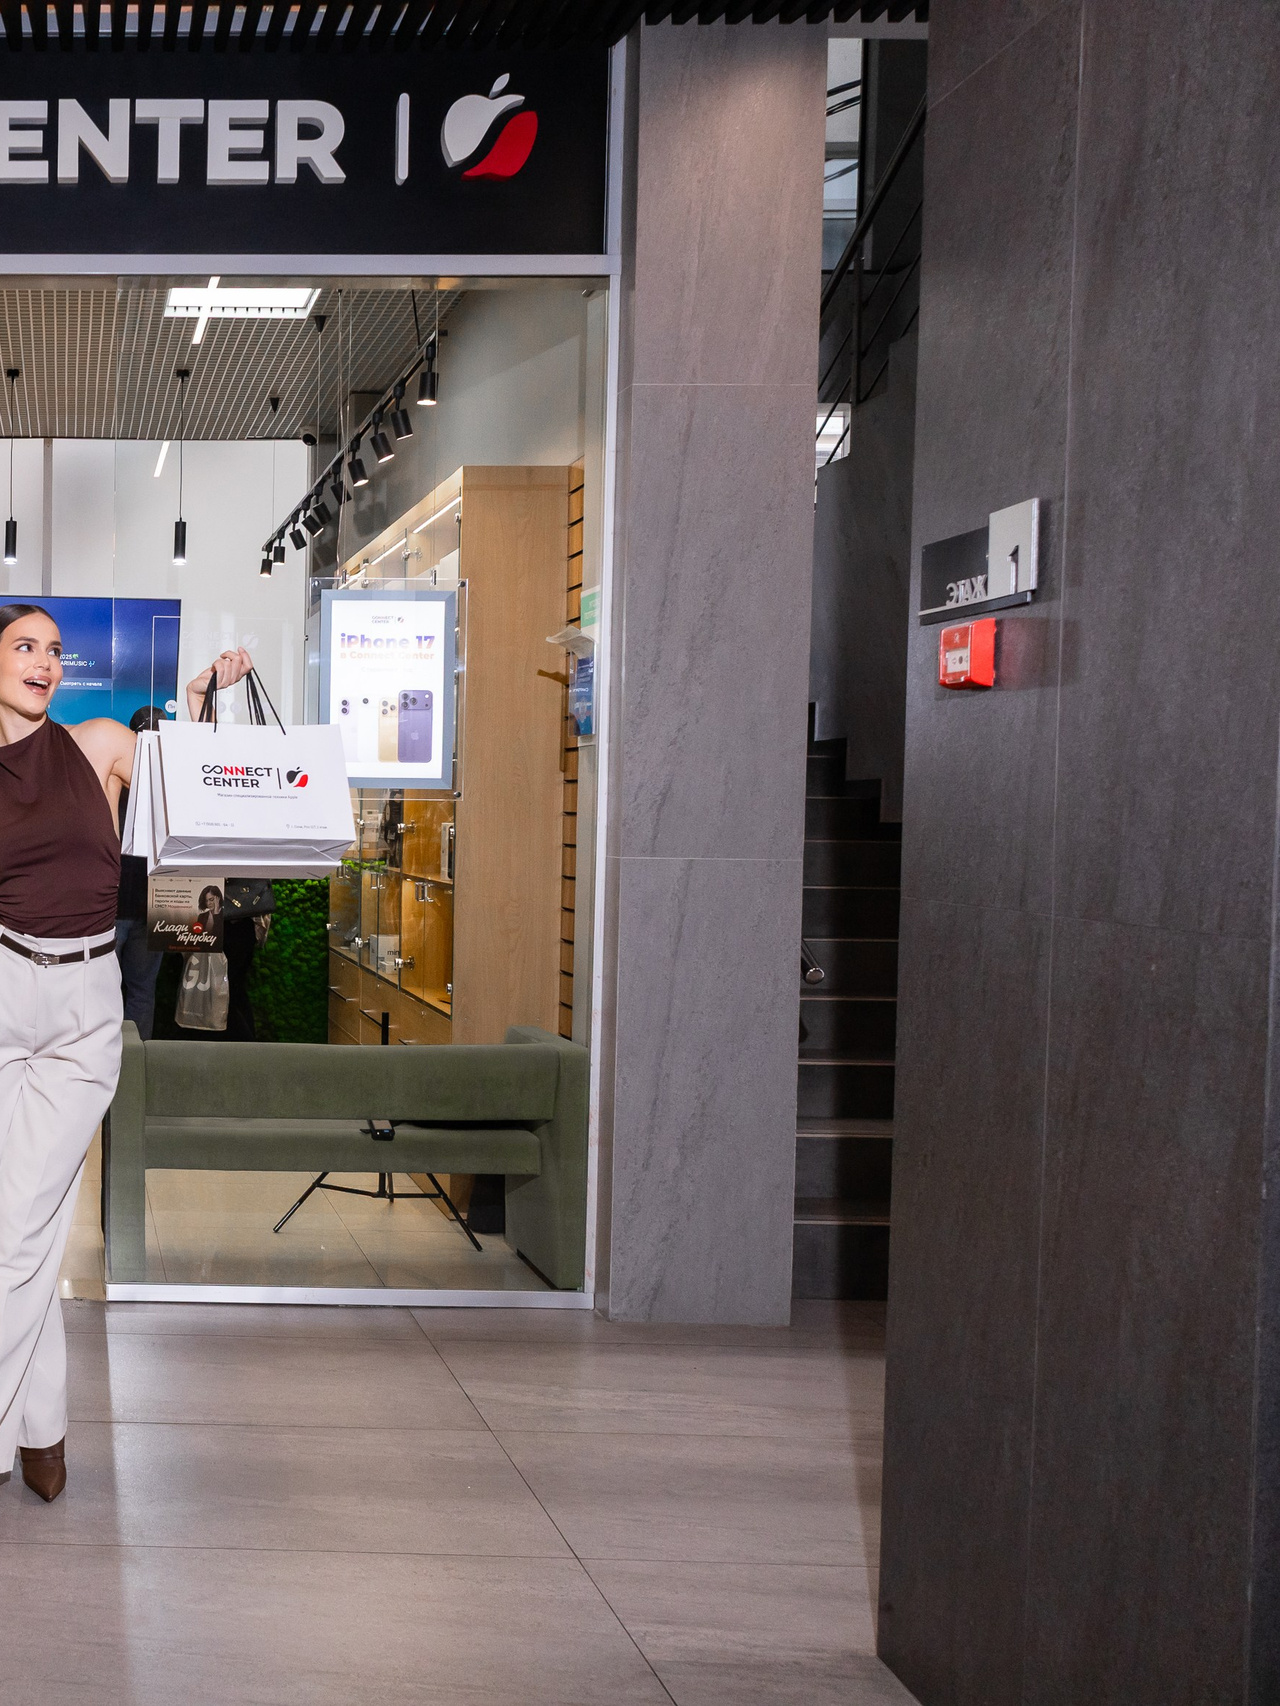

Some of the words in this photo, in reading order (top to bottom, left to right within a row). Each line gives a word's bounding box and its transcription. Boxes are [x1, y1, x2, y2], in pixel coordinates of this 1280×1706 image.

[946, 574, 988, 607] ЭТАЖ
[1006, 545, 1020, 595] 1
[340, 633, 411, 649] iPhone
[415, 635, 436, 650] 17
[349, 651, 394, 660] Connect
[399, 651, 435, 660] Center
[201, 764, 272, 778] CONNECT
[203, 776, 260, 789] CENTER
[153, 920, 189, 935] Клади
[177, 931, 217, 946] трубку
